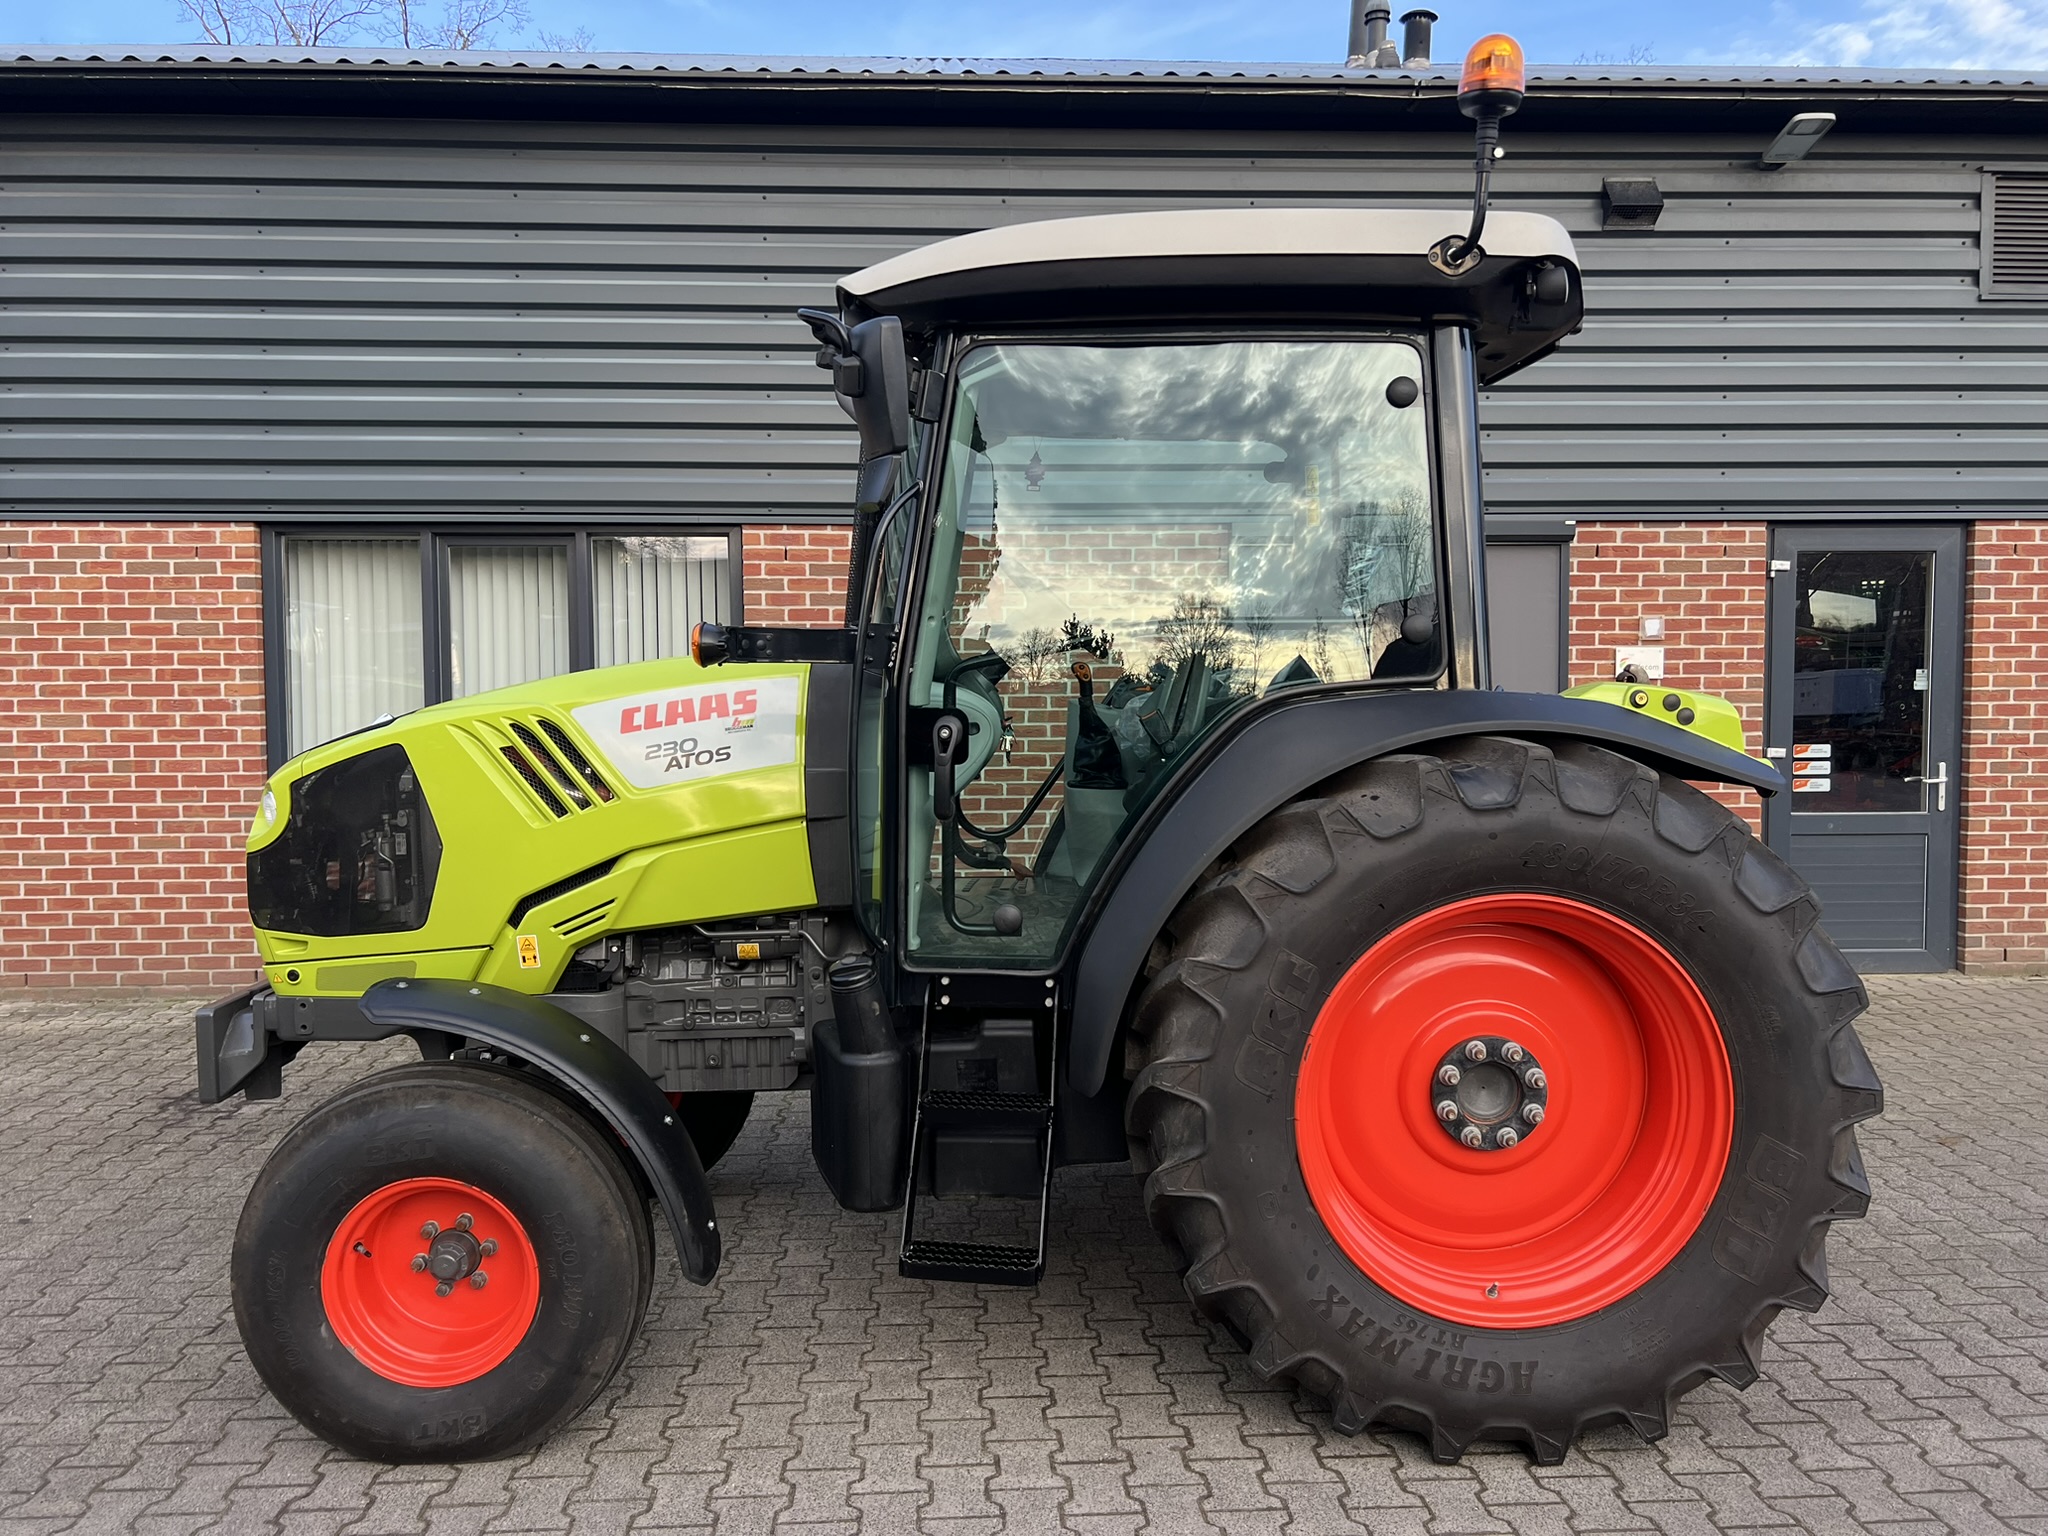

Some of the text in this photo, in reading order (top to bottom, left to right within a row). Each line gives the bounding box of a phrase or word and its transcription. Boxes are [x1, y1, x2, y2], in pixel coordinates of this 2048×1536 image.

[620, 689, 757, 734] CLAAS
[645, 737, 699, 760] 230
[664, 745, 731, 772] ATOS
